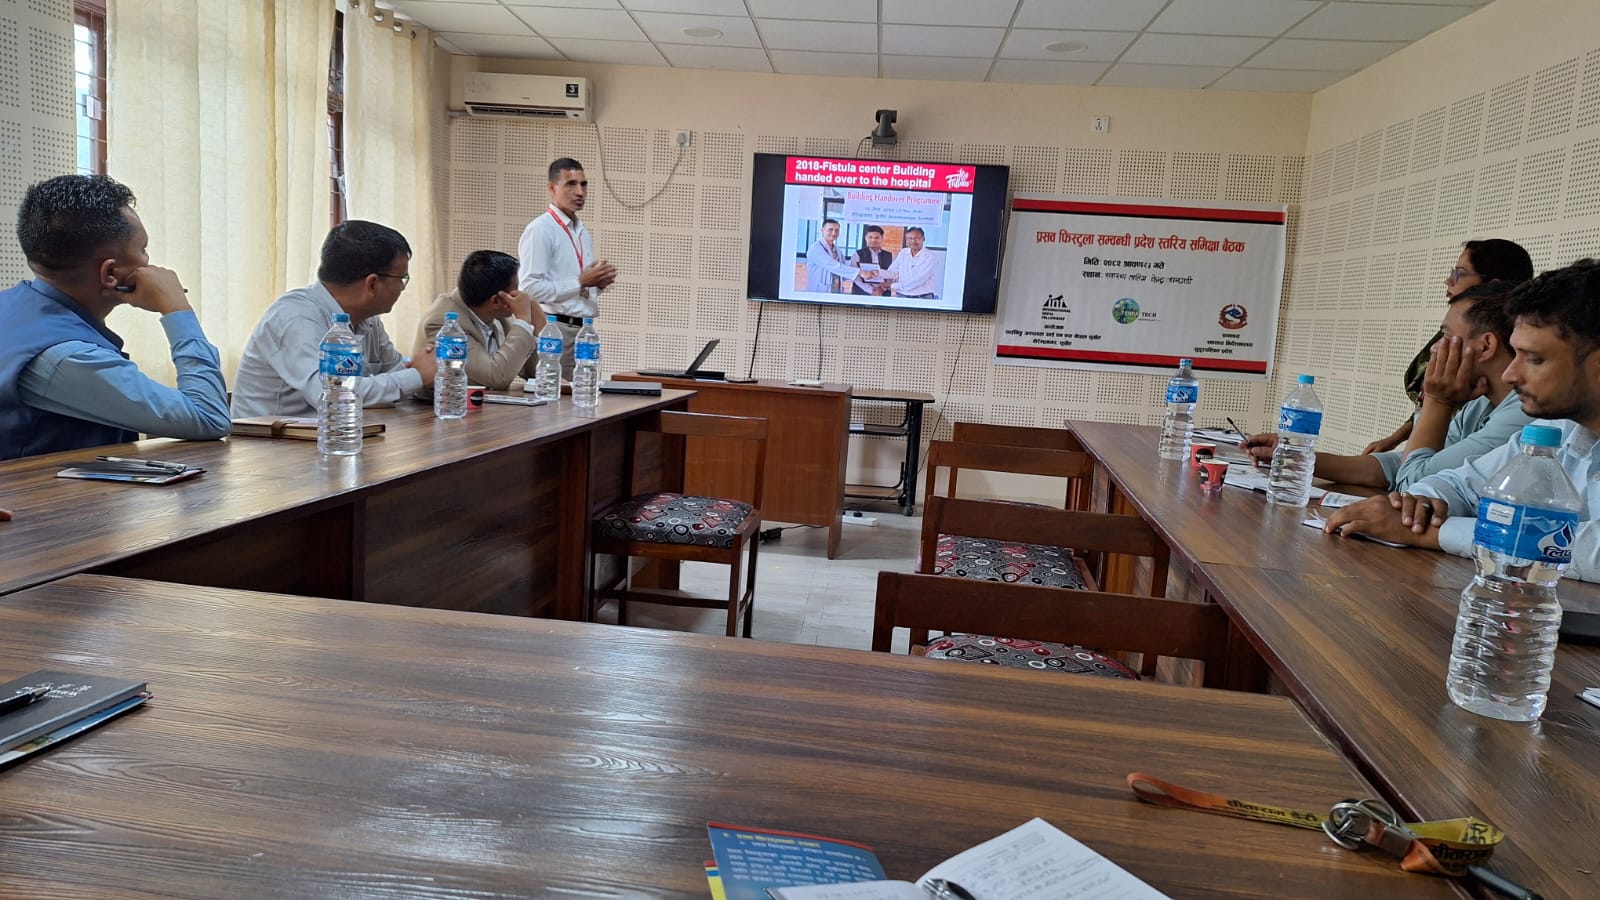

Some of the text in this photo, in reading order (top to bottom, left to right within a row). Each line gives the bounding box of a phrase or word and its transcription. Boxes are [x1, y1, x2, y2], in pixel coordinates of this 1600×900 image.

[795, 159, 856, 173] 2018-Fistula
[859, 164, 891, 174] center
[893, 165, 936, 179] Building
[795, 172, 833, 183] handed
[835, 174, 858, 184] over
[859, 175, 870, 185] to
[872, 175, 889, 186] the
[891, 176, 932, 189] hospital
[847, 191, 873, 202] Building
[1058, 228, 1095, 247] फिस्टुला
[1134, 233, 1156, 249] प्रदेश
